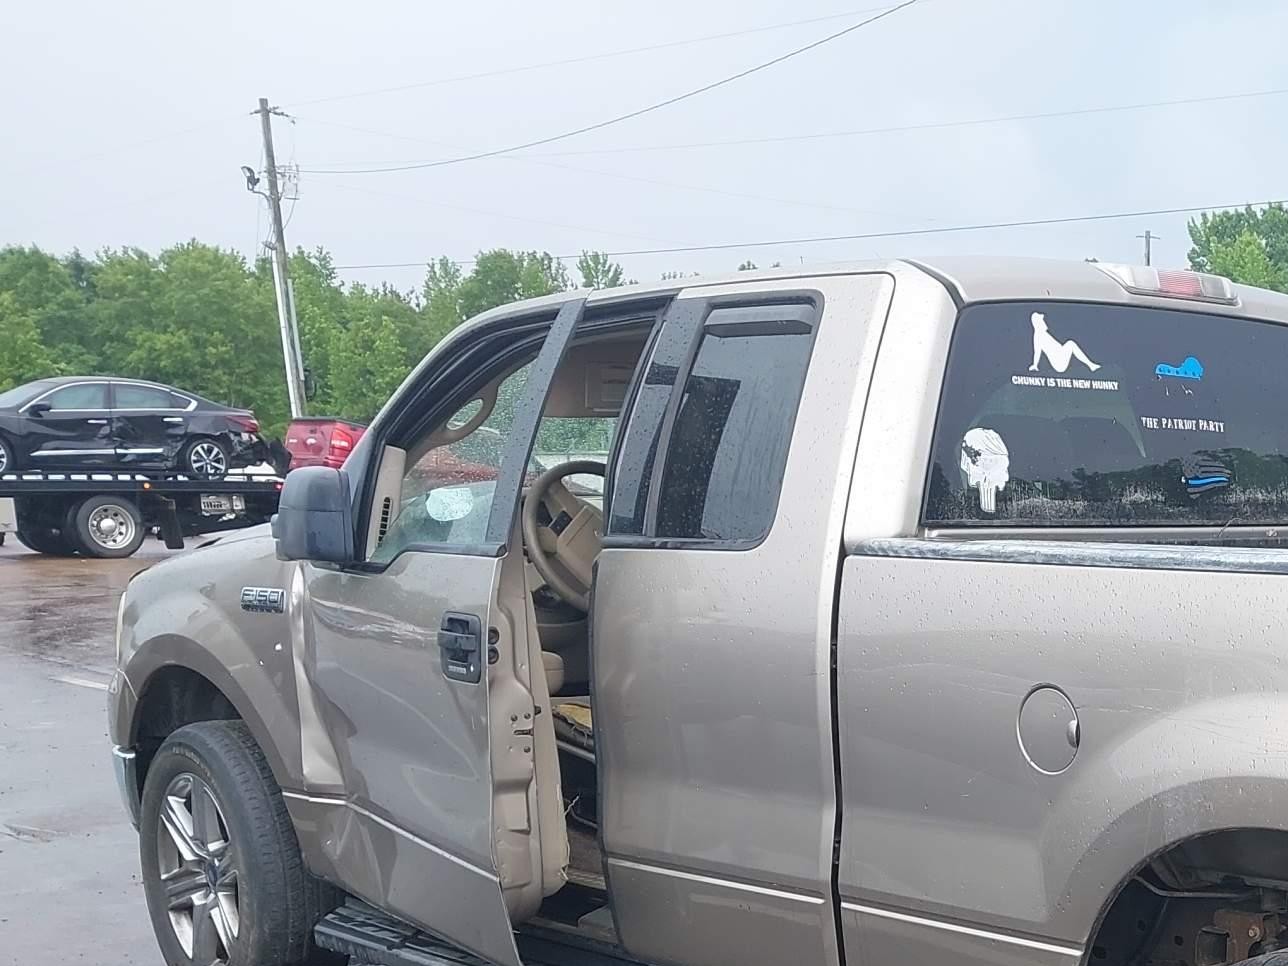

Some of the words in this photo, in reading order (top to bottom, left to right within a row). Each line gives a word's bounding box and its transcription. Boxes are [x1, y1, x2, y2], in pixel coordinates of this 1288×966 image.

[1011, 375, 1046, 386] CHUNKY
[1047, 378, 1055, 387] IS
[1056, 378, 1072, 388] THE
[1072, 379, 1091, 389] NEW
[1092, 381, 1119, 391] HUNKY
[1141, 416, 1159, 429] THE
[1161, 417, 1197, 431] PATRIOT
[1199, 419, 1225, 433] PARTY
